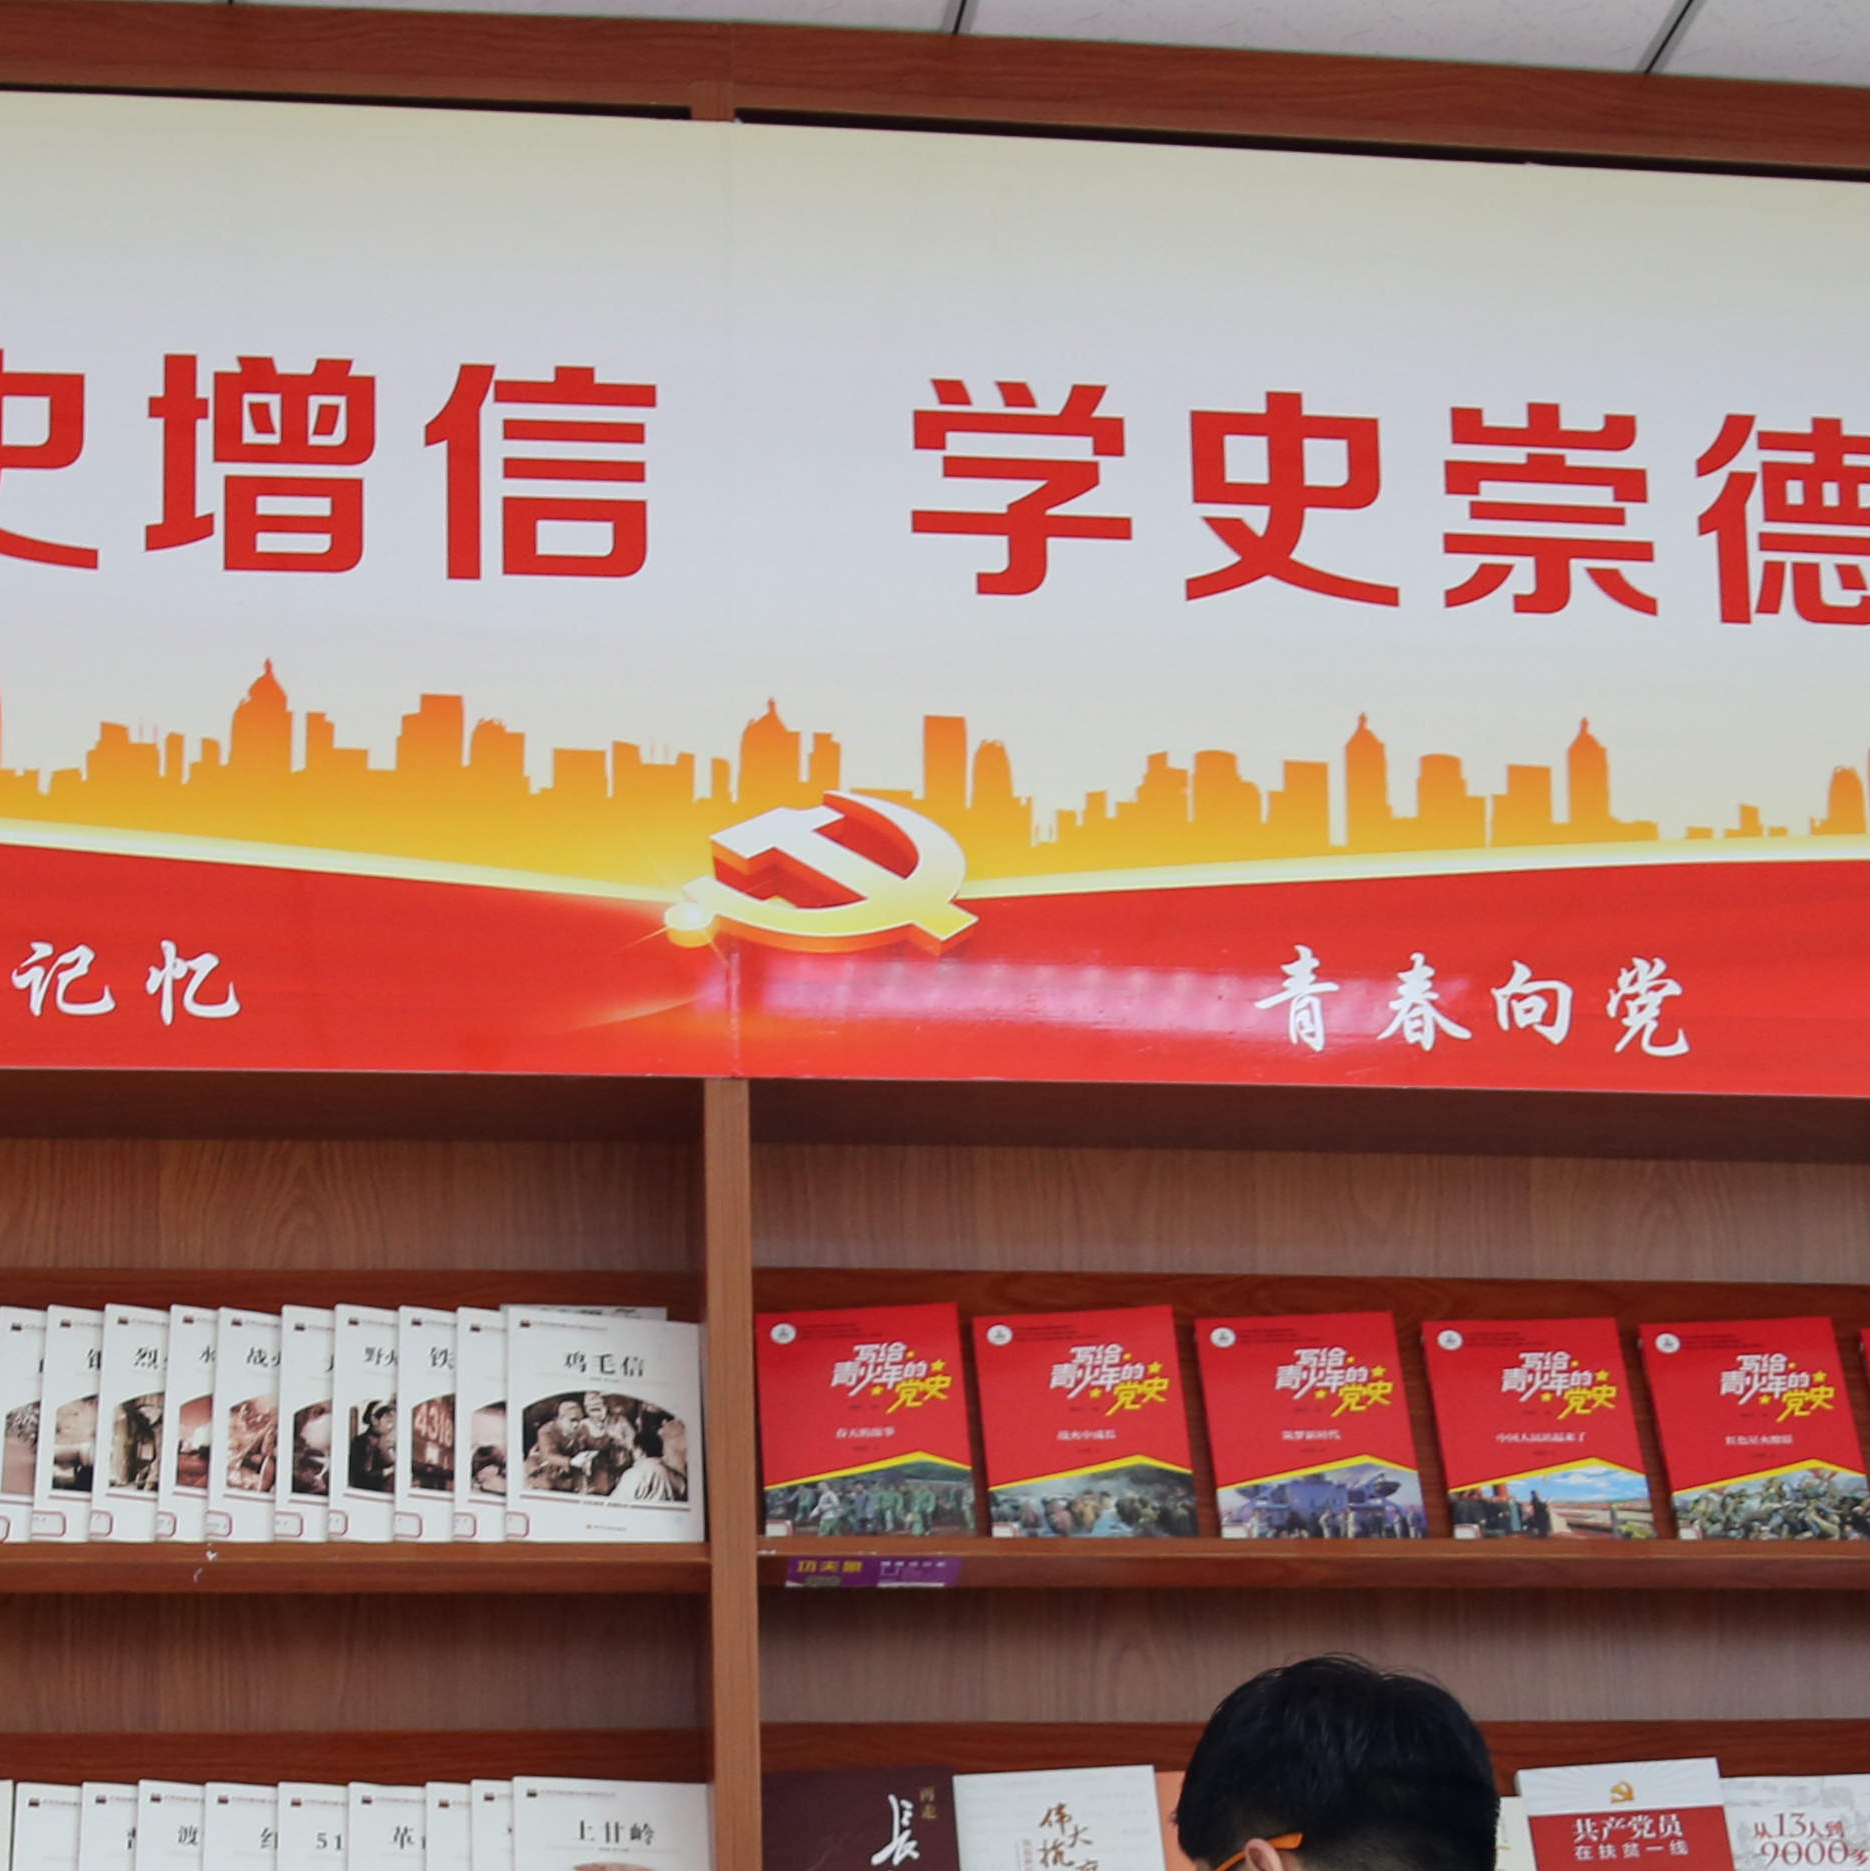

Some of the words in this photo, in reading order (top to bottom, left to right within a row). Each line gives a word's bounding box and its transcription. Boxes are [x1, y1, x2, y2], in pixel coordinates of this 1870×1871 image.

[1253, 943, 1692, 1059] 青春向党
[564, 1349, 646, 1378] 鸡毛信
[854, 1342, 907, 1363] 写给
[1070, 1343, 1124, 1364] 写给
[1294, 1346, 1347, 1367] 写给
[1519, 1350, 1570, 1372] 写给
[1735, 1352, 1787, 1373] 写给
[830, 1360, 928, 1397] 青少年的
[886, 1375, 952, 1414] 党史
[1048, 1361, 1145, 1399] 青少年的
[1274, 1364, 1369, 1401] 青少年的
[1501, 1368, 1593, 1402] 青少年的
[1720, 1369, 1810, 1405] 青少年的
[1105, 1376, 1170, 1416] 党史
[1331, 1379, 1394, 1417] 党史
[1557, 1384, 1617, 1420] 党史
[1775, 1386, 1835, 1423] 党史
[577, 1819, 656, 1847] 上甘岭
[1572, 1815, 1684, 1840] 共产党员
[1753, 1812, 1845, 1840] 从13人到
[1574, 1840, 1689, 1862] 在扶贫一线
